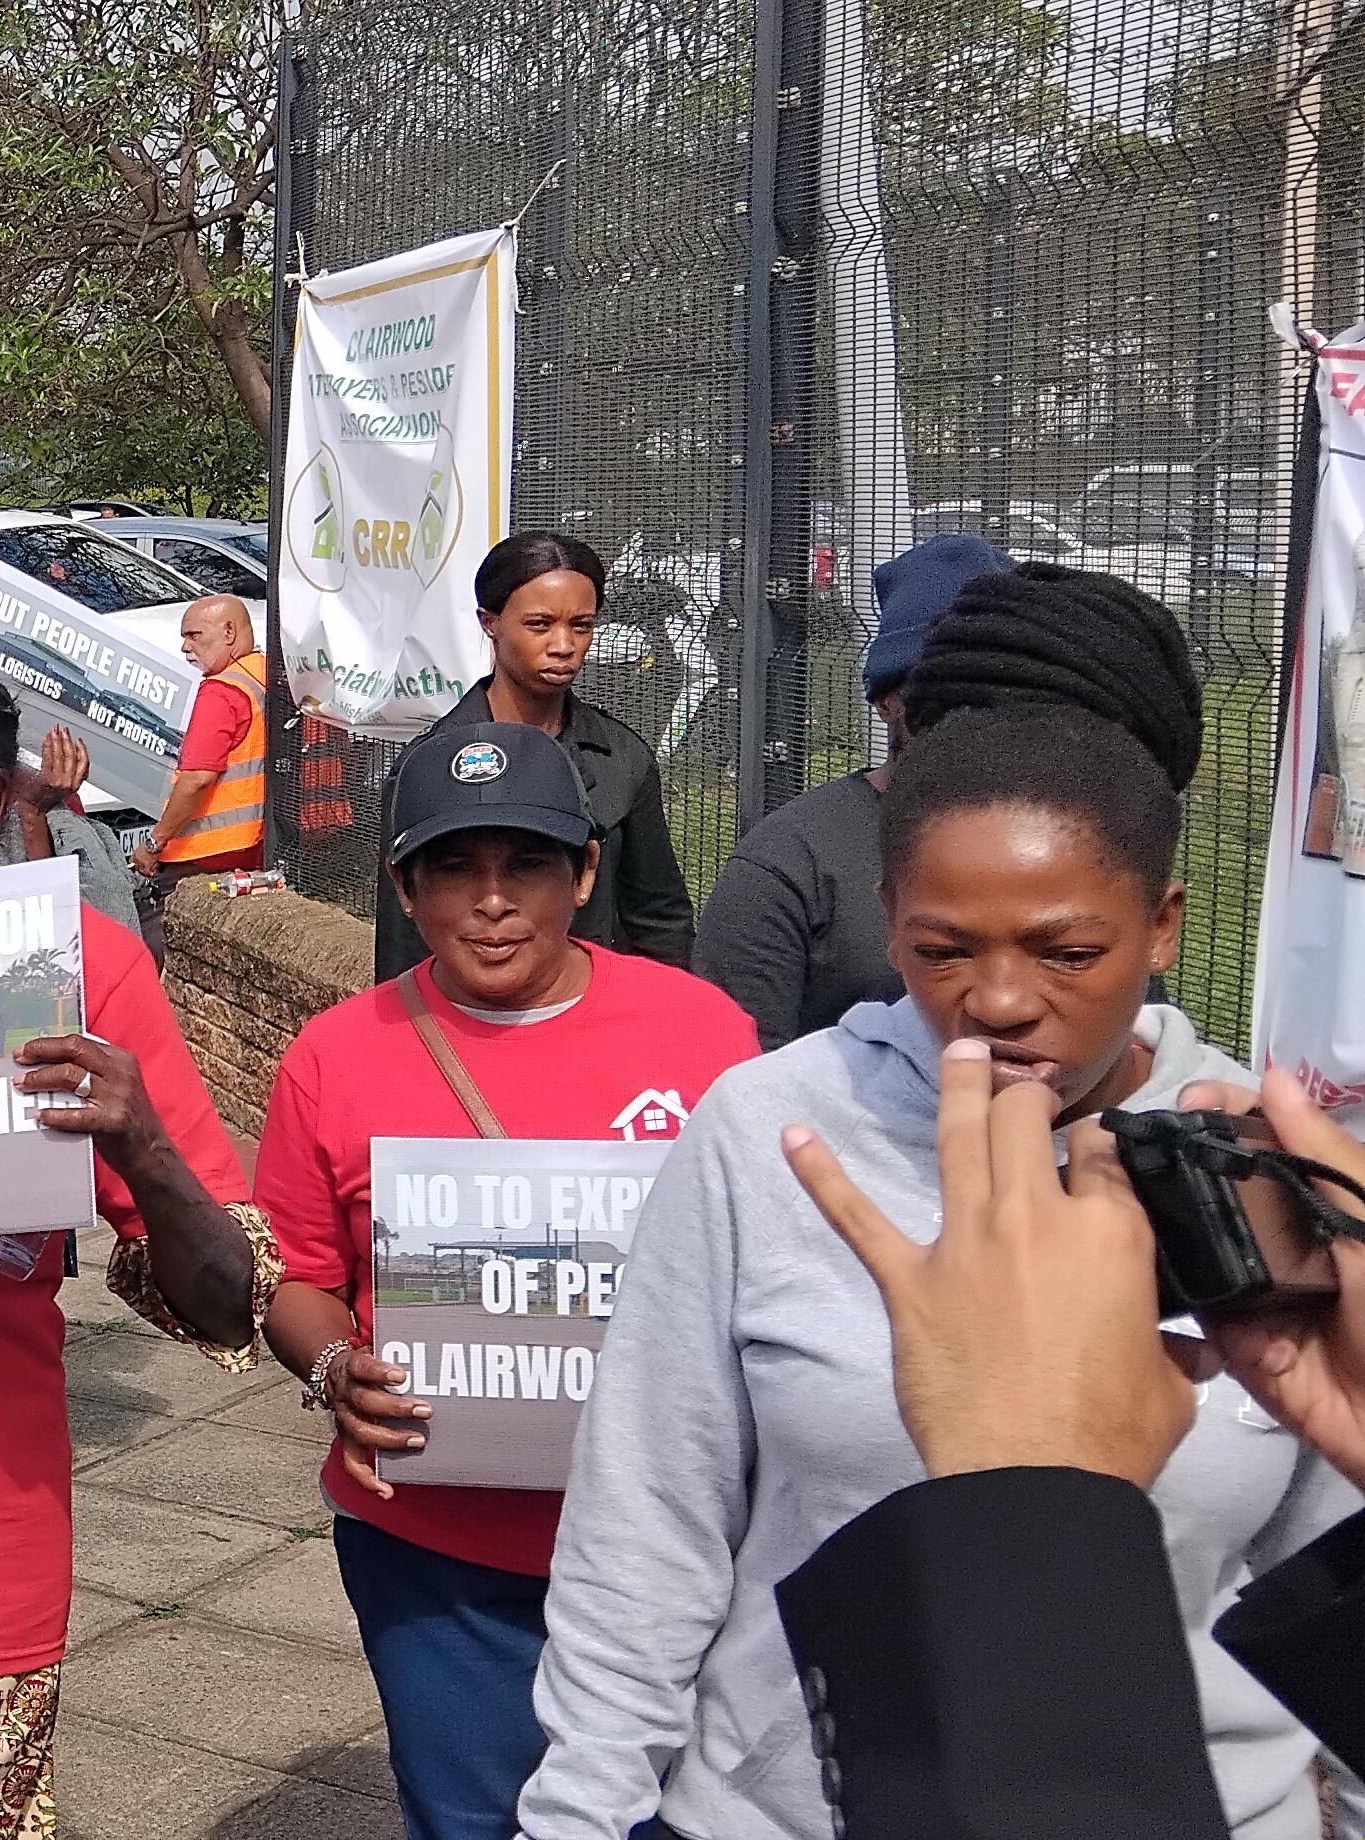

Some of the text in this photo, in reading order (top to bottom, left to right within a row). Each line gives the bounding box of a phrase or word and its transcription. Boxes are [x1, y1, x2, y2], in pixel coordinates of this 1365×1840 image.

[346, 314, 436, 362] CLAIRWOOD
[352, 518, 411, 570] CRR
[30, 606, 116, 677] PEOPLE
[116, 656, 180, 711] FIRST
[87, 700, 168, 757] NOT PROFITS
[396, 1174, 458, 1228] NO
[474, 1176, 532, 1230] TO
[481, 1260, 539, 1315] OF
[381, 1341, 601, 1402] CLAIRWO
